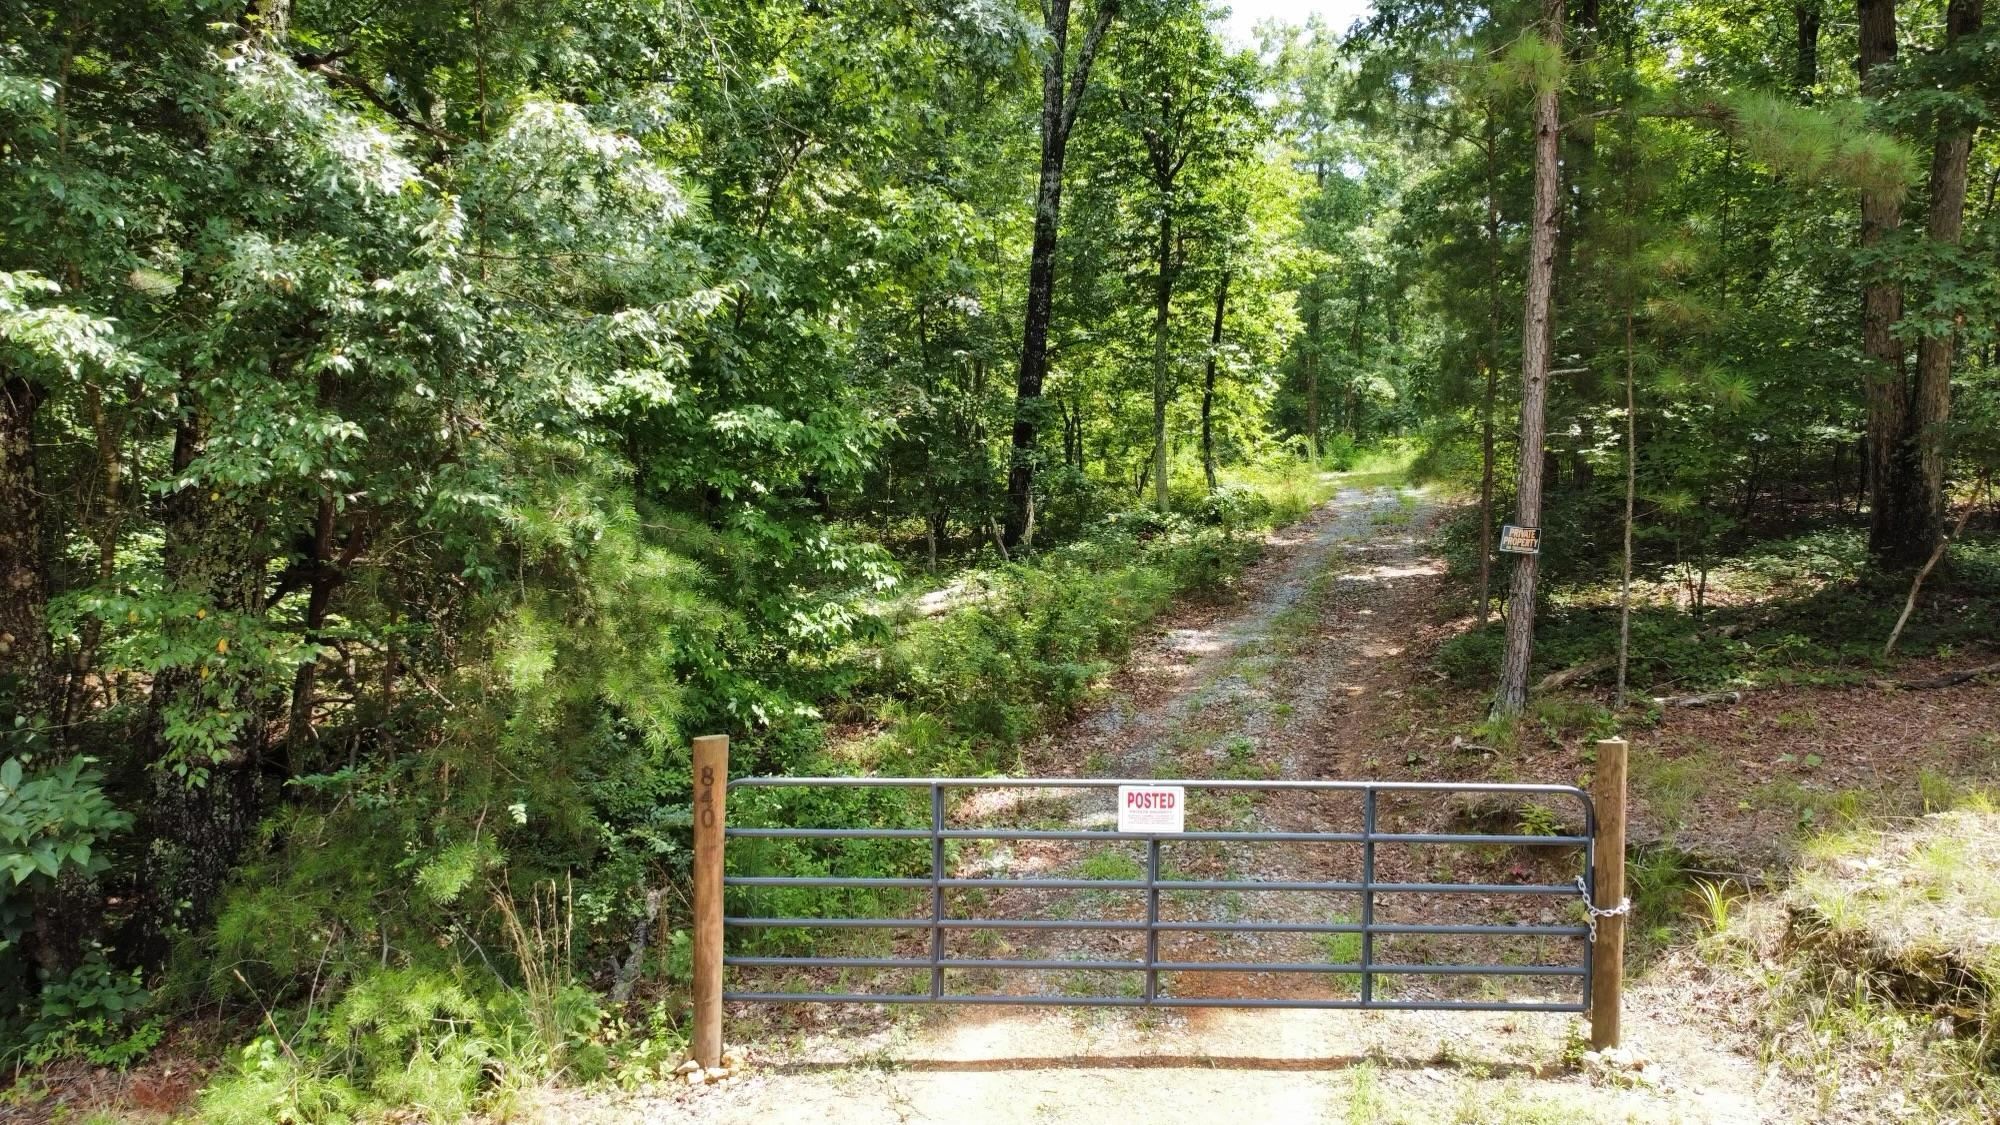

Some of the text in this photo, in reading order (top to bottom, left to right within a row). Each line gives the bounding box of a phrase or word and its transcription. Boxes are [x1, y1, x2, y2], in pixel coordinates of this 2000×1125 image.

[1509, 528, 1536, 539] PRIVATE
[1503, 536, 1539, 548] PROPERTY
[700, 765, 715, 828] 840
[1127, 792, 1175, 809] POSTED
